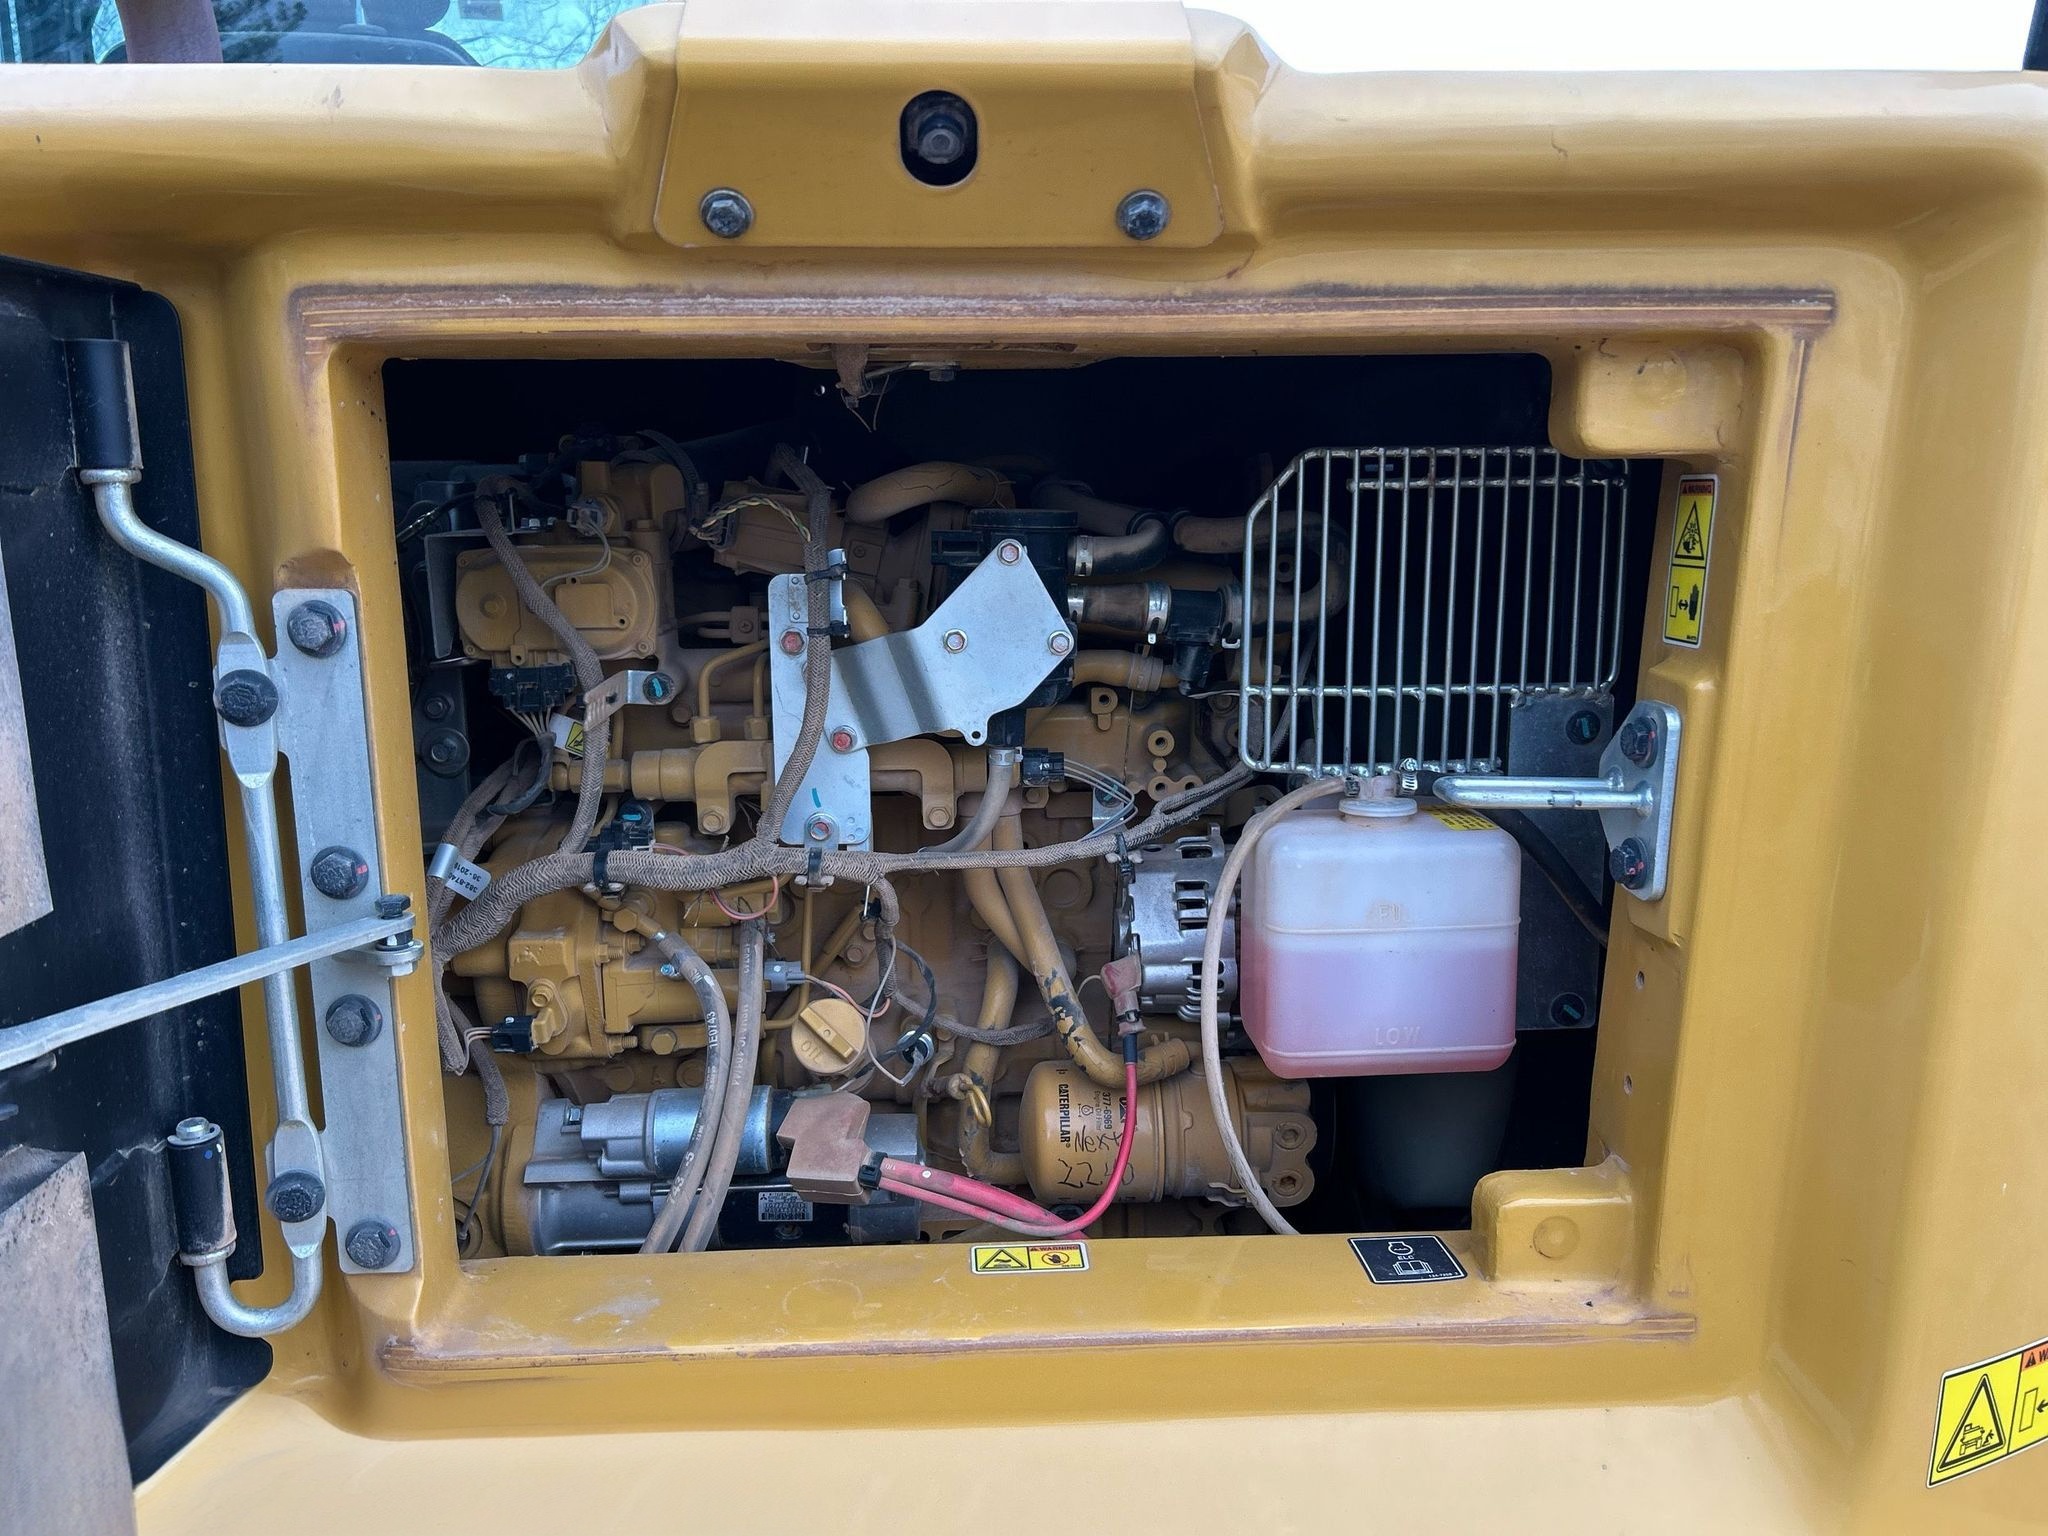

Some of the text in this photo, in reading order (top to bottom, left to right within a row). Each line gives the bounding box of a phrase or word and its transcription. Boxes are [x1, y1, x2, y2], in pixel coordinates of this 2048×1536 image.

[706, 1011, 718, 1048] 1E0743
[1374, 1026, 1421, 1045] LOW
[801, 1040, 823, 1064] OIL
[1058, 1083, 1071, 1143] CATERPILLAR
[1102, 1092, 1112, 1130] 377-6969
[1074, 1125, 1123, 1153] Next
